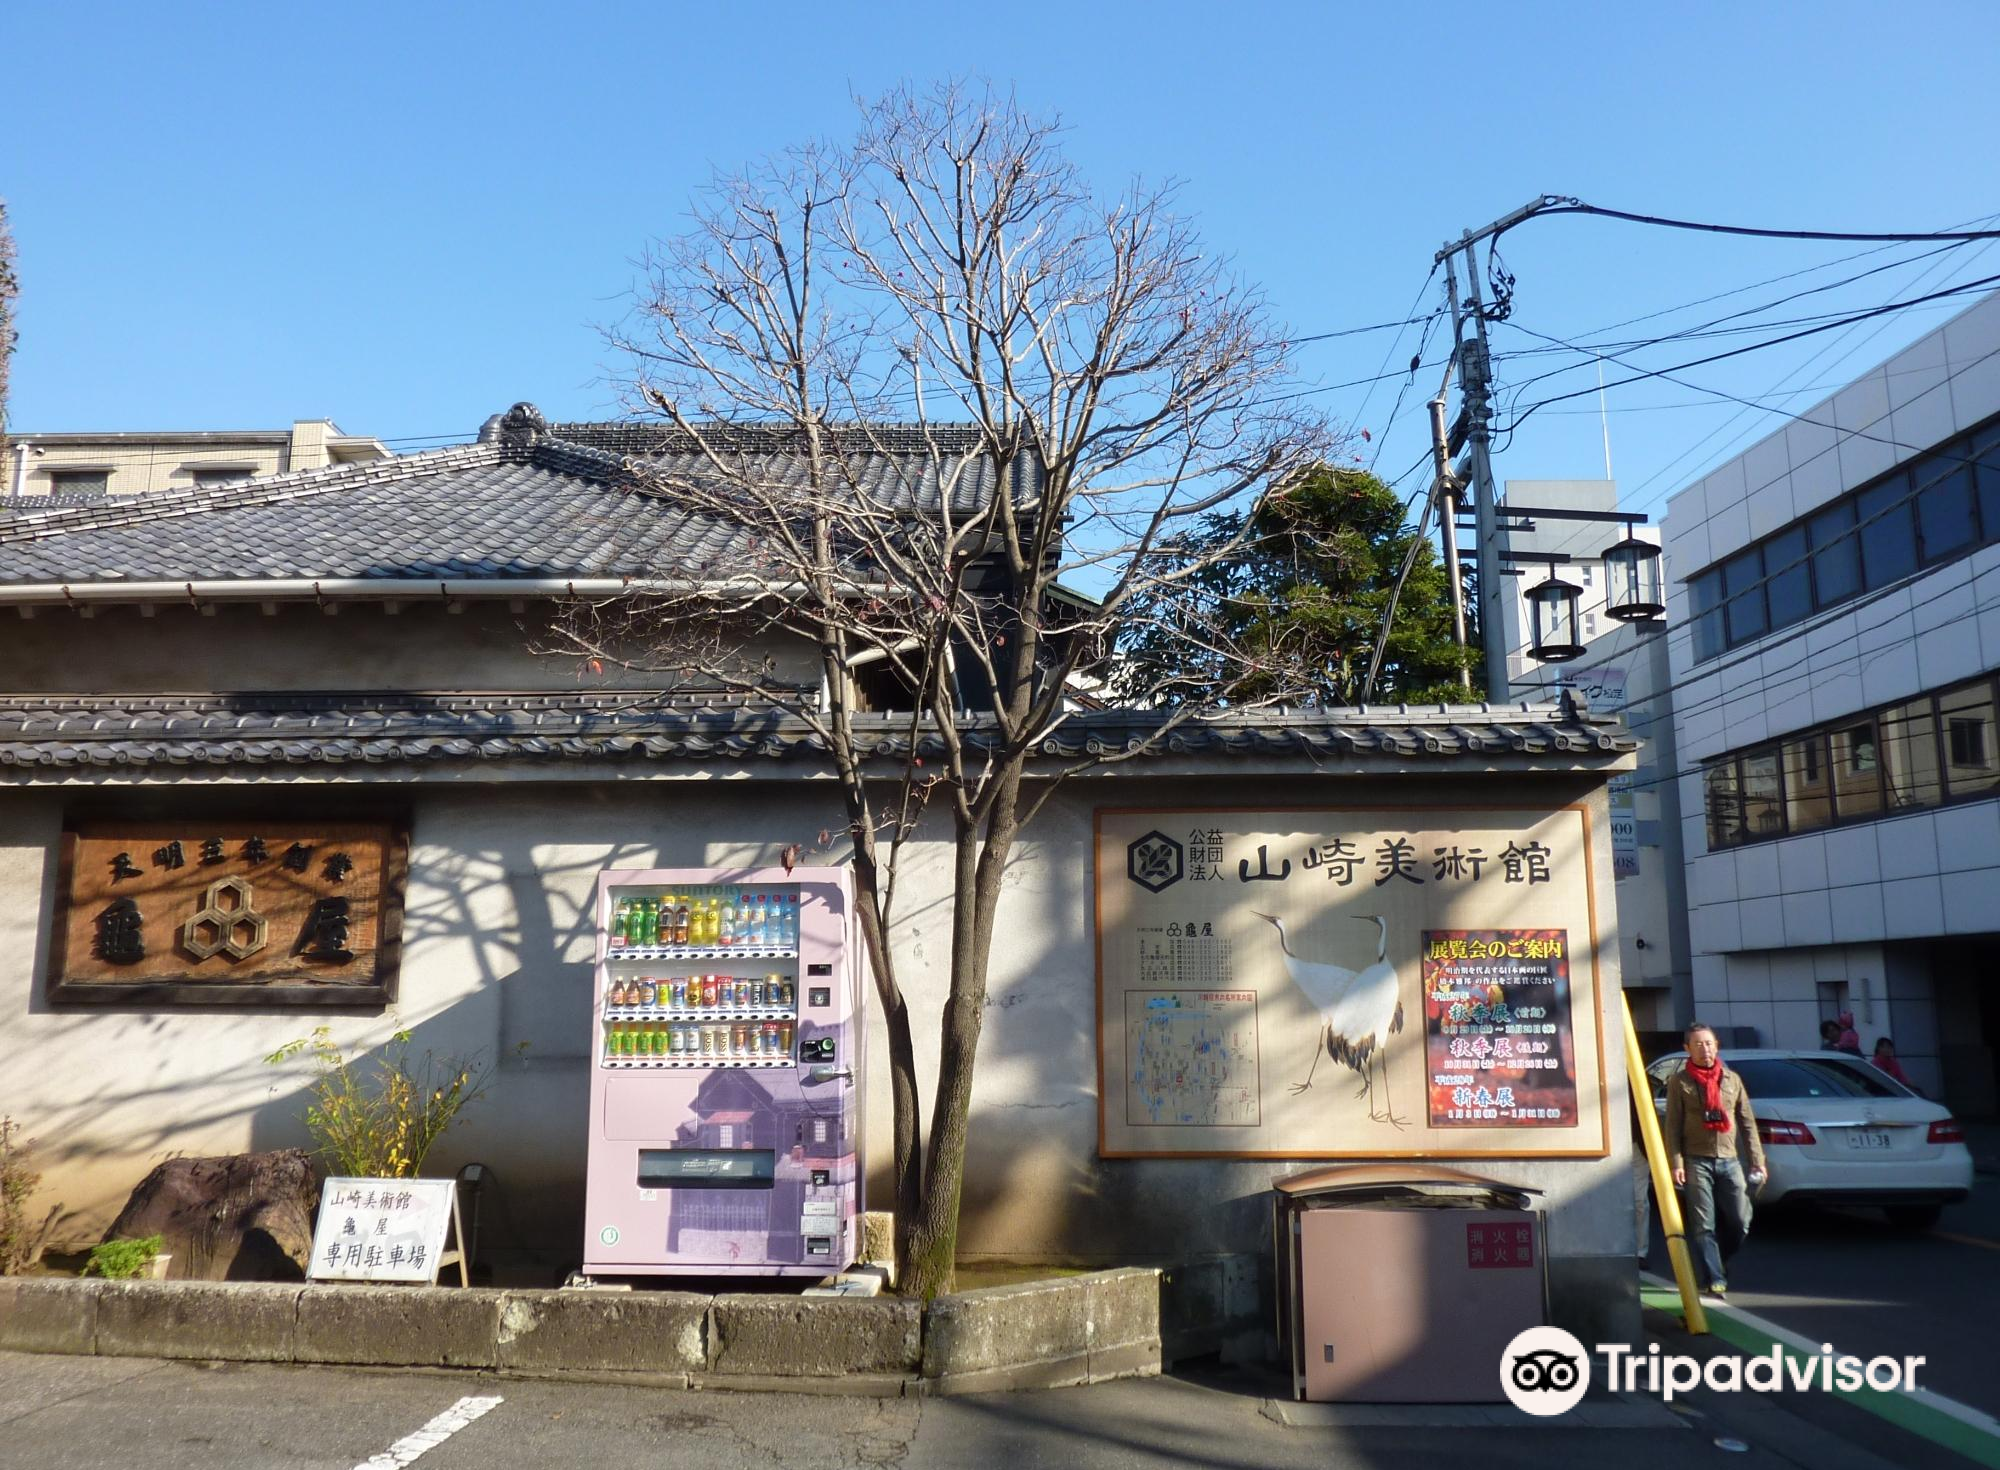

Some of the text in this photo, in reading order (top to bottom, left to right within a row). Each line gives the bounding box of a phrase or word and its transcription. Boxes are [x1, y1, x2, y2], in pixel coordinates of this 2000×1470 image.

[1189, 828, 1224, 845] 公益
[1189, 847, 1224, 863] 財団
[1238, 836, 1552, 888] 山崎美術館
[1615, 857, 1635, 869] 08
[1189, 865, 1224, 881] 法人
[672, 884, 742, 896] SUNTORY
[1430, 938, 1563, 959] 展覧会のご案内
[1448, 1002, 1511, 1024] 秋季展
[1449, 1037, 1513, 1059] 秋季展
[1452, 1086, 1516, 1107] 新春展
[1858, 1134, 1891, 1147] 11-38
[330, 1190, 413, 1210] 山崎美術館
[1470, 1228, 1529, 1245] 消火栓
[322, 1241, 428, 1270] 専用駐車場
